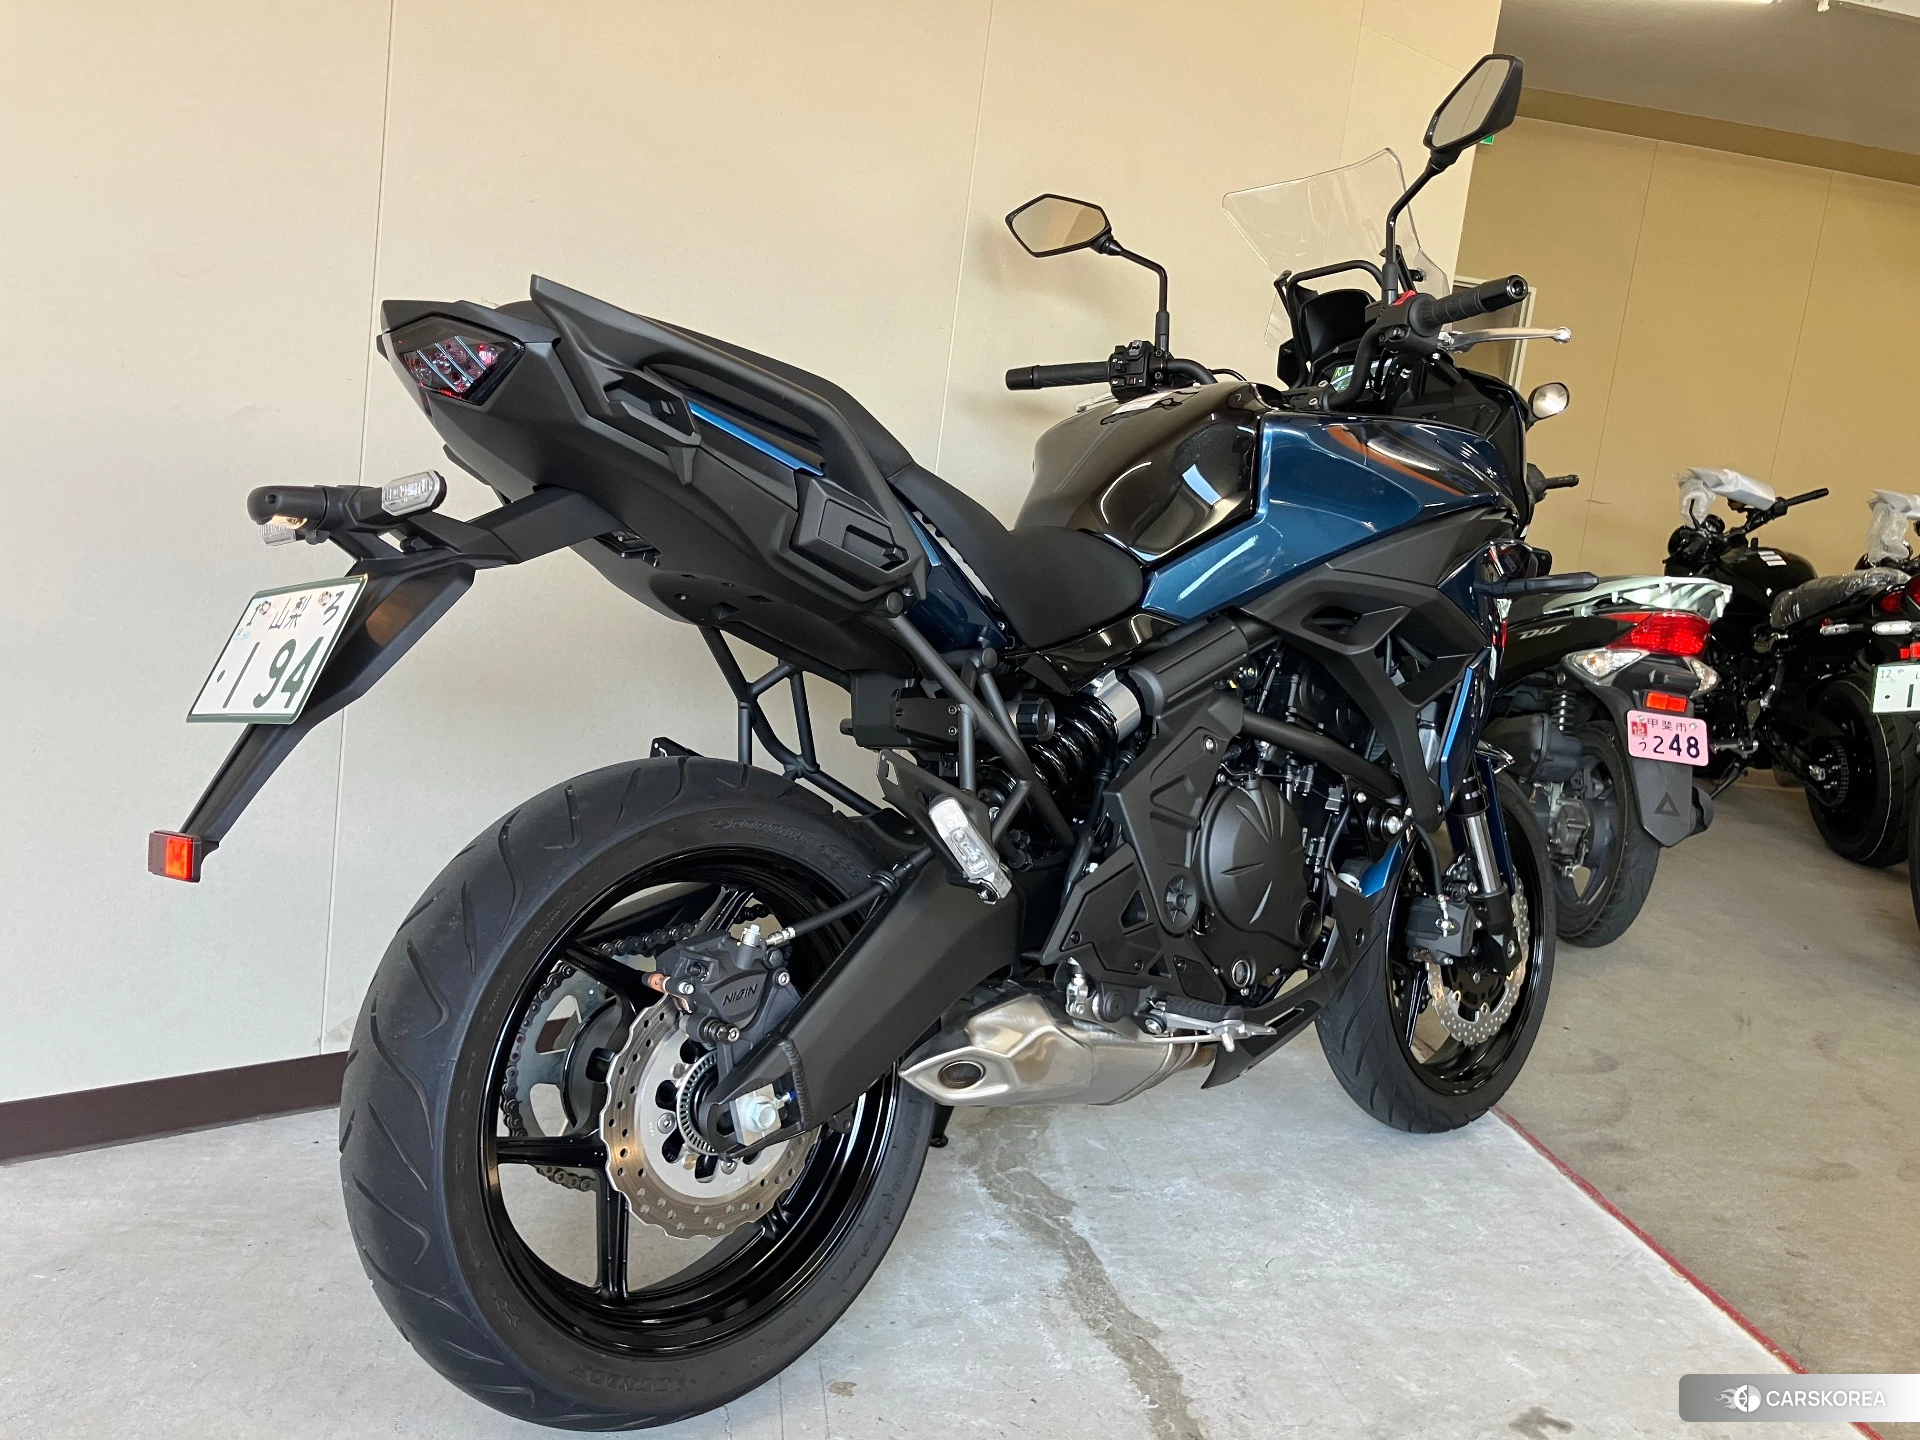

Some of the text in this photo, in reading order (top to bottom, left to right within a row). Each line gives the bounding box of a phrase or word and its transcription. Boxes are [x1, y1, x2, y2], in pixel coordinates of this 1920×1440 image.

[268, 595, 312, 630] 山梨
[1648, 718, 1687, 732] 甲斐市
